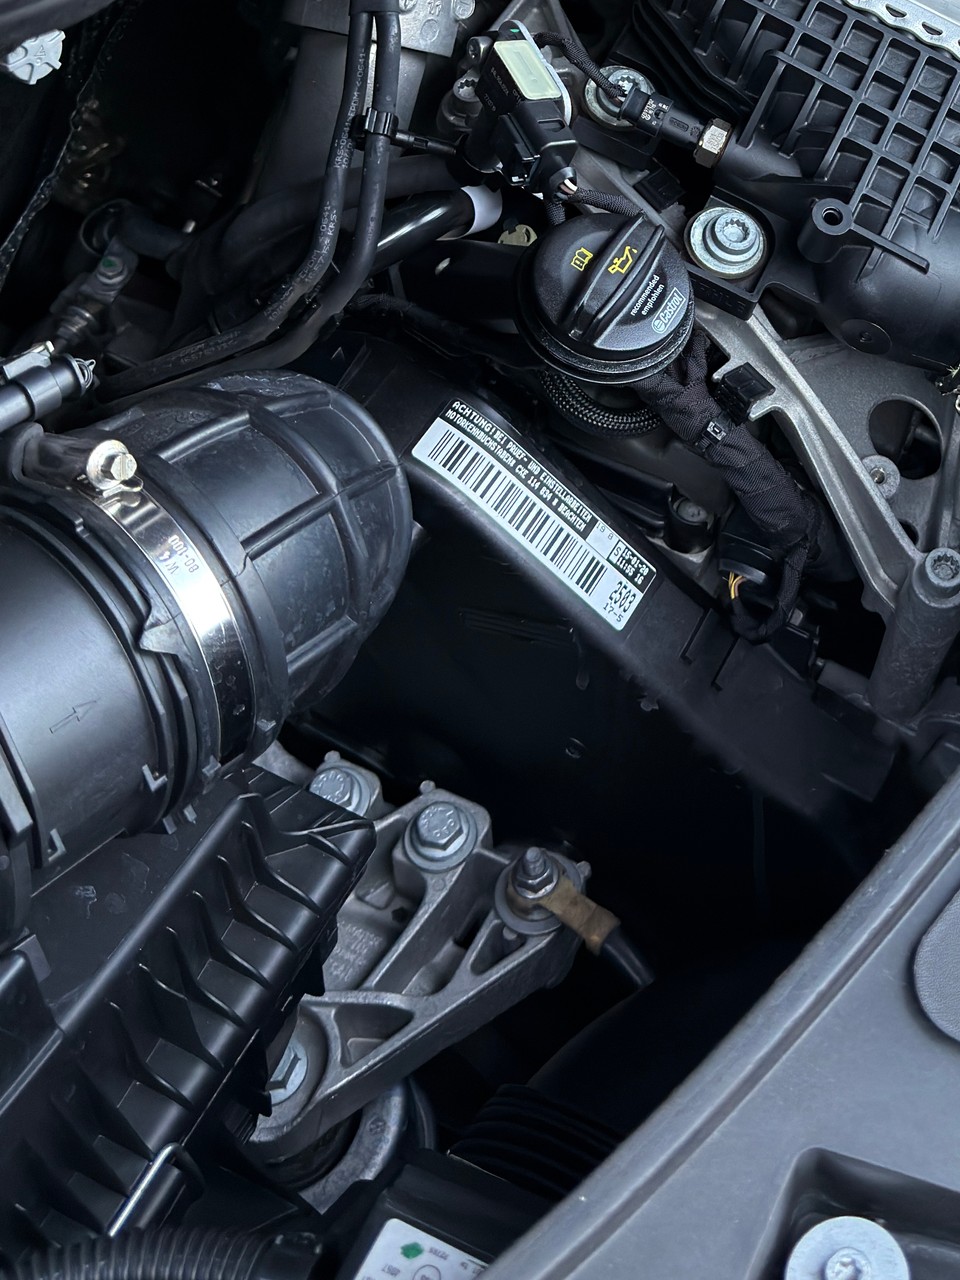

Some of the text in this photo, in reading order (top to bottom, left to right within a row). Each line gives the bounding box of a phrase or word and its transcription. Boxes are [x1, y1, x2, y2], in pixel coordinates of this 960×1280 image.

[630, 274, 660, 316] recommended
[641, 284, 665, 316] empfohlen
[659, 292, 683, 323] Castrol
[452, 401, 496, 435] ACHTUNG!
[505, 441, 530, 461] PRUEF-
[537, 471, 595, 522] EINSTELLARBEITEN
[557, 502, 586, 531] BEACHTEN
[613, 546, 621, 556] S
[616, 556, 635, 576] 11:55
[621, 548, 652, 575] 15-01-20
[608, 580, 636, 613] 2503
